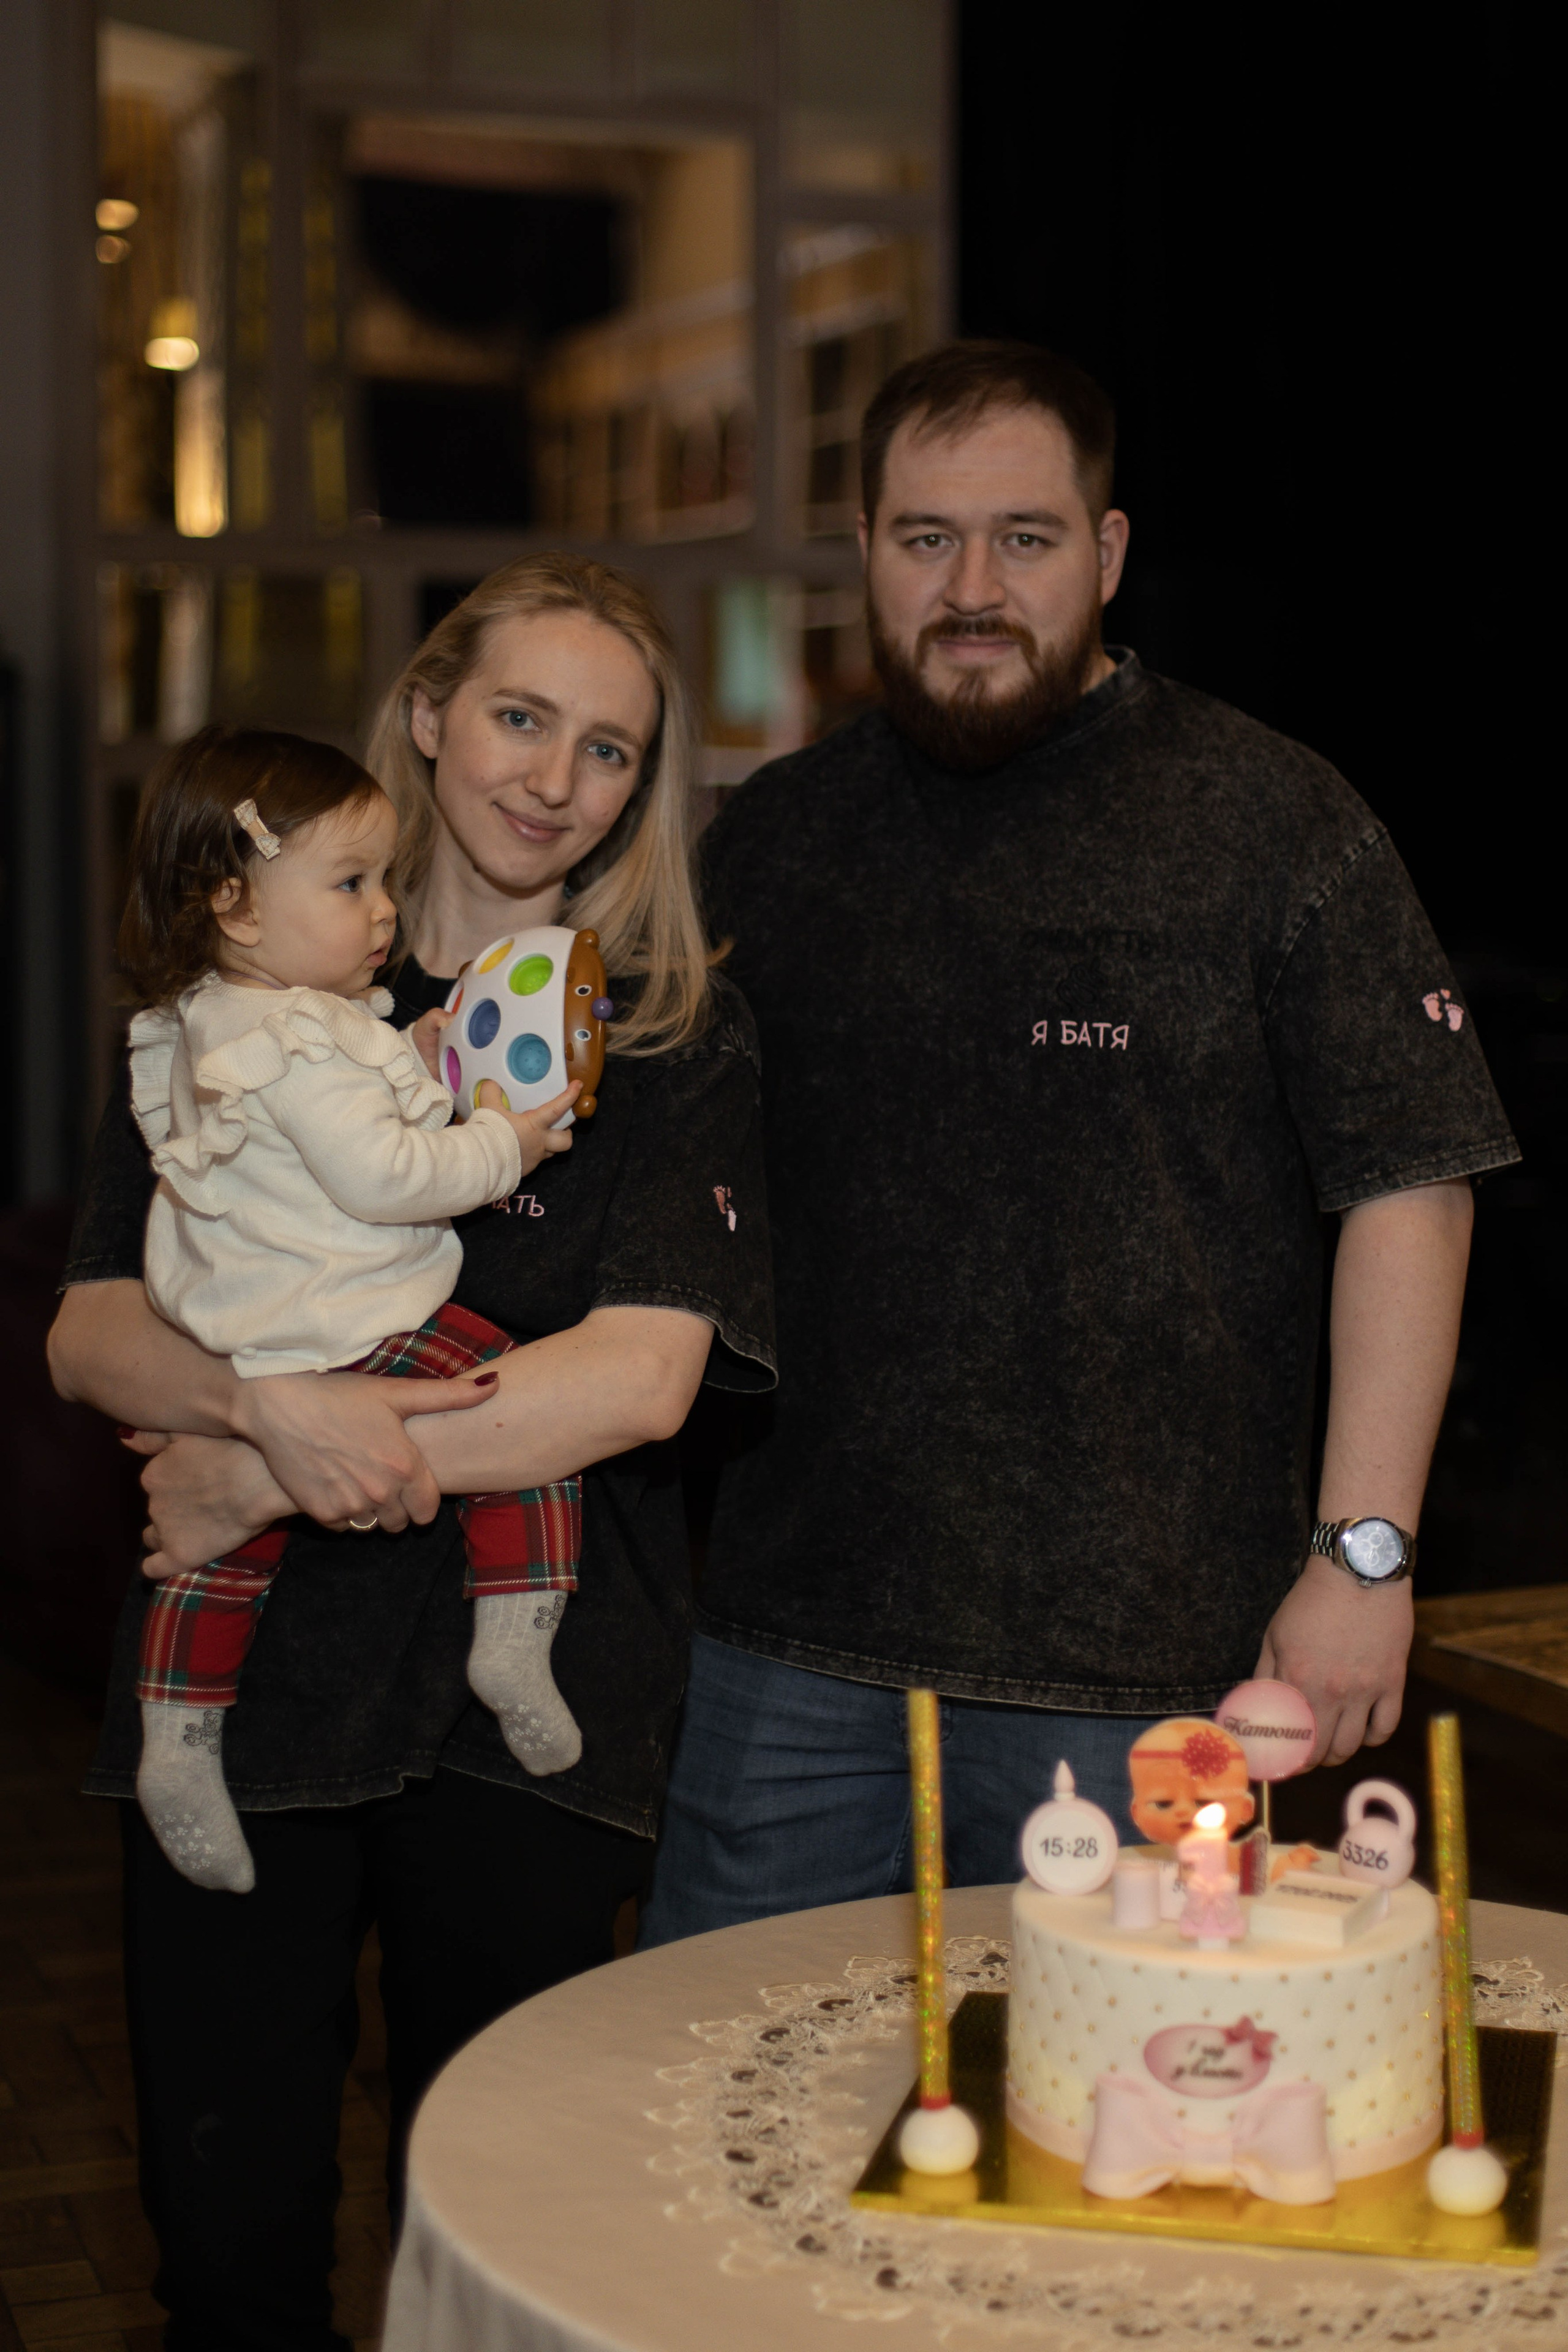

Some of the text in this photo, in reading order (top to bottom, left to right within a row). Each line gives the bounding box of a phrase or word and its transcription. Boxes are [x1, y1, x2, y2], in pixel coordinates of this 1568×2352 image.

[1031, 1020, 1129, 1050] Я БАТЯ
[492, 1194, 545, 1217] АТЬ
[1224, 1716, 1313, 1741] Катюша
[1040, 1836, 1098, 1858] 15:28
[1343, 1839, 1389, 1871] 3326
